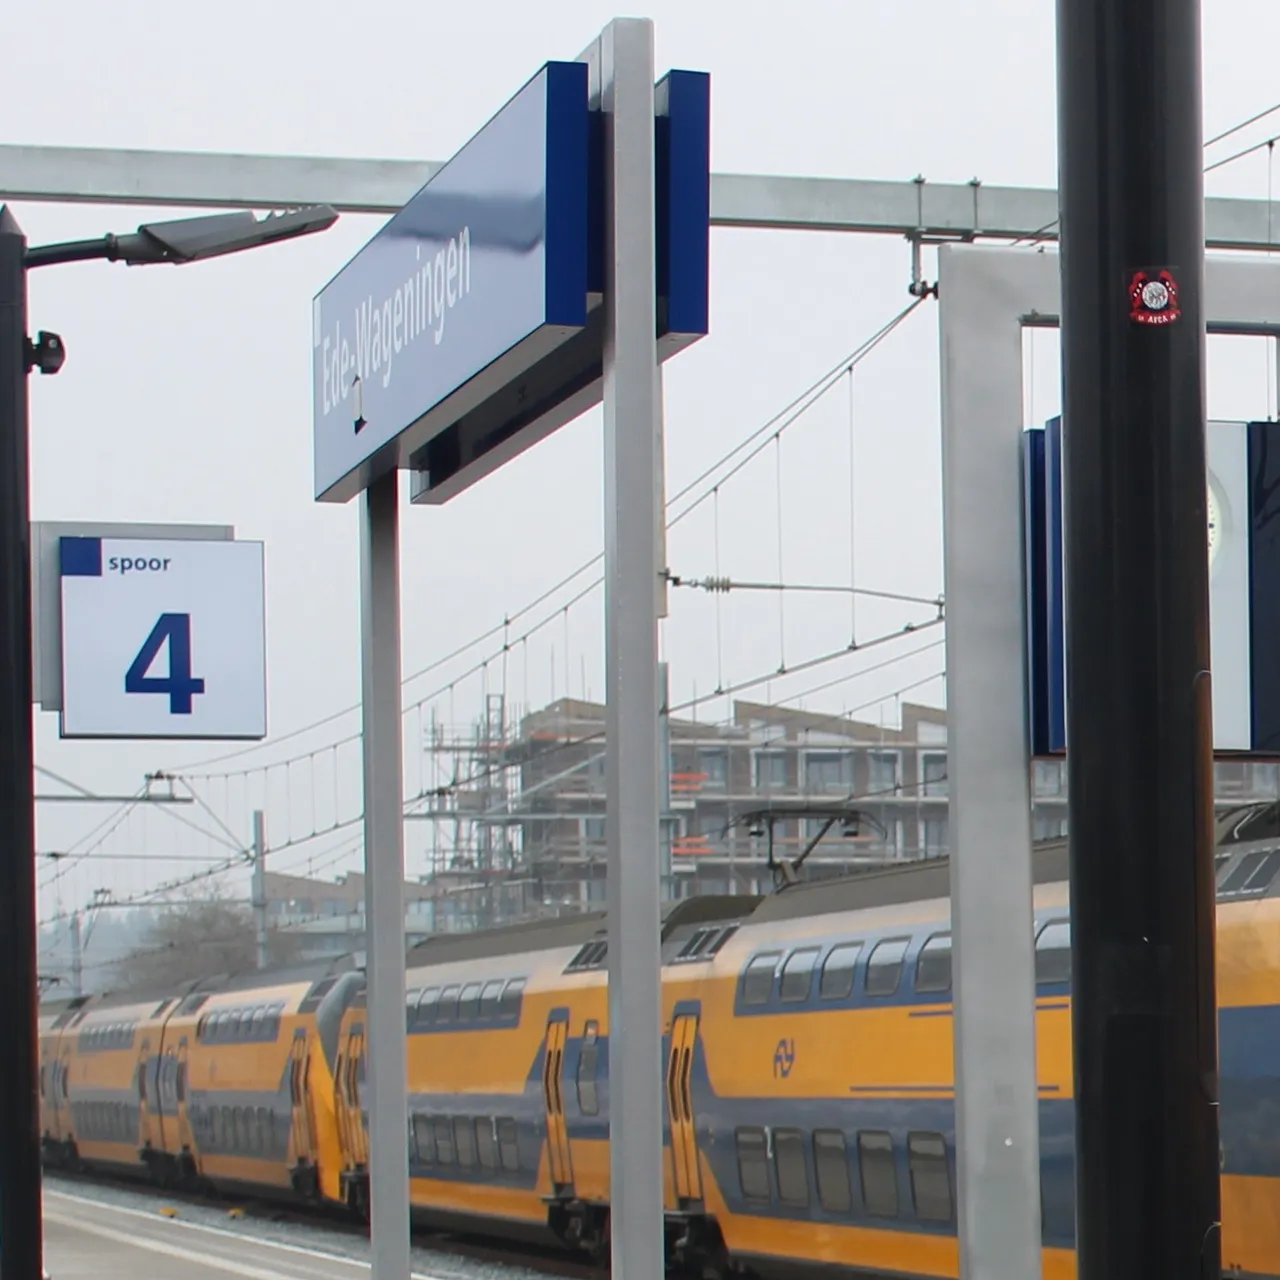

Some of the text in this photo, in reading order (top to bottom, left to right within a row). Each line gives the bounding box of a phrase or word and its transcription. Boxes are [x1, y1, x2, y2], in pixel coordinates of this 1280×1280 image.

[322, 226, 472, 416] Ede-Wageningen
[108, 556, 172, 575] spoor
[125, 612, 206, 715] 4
